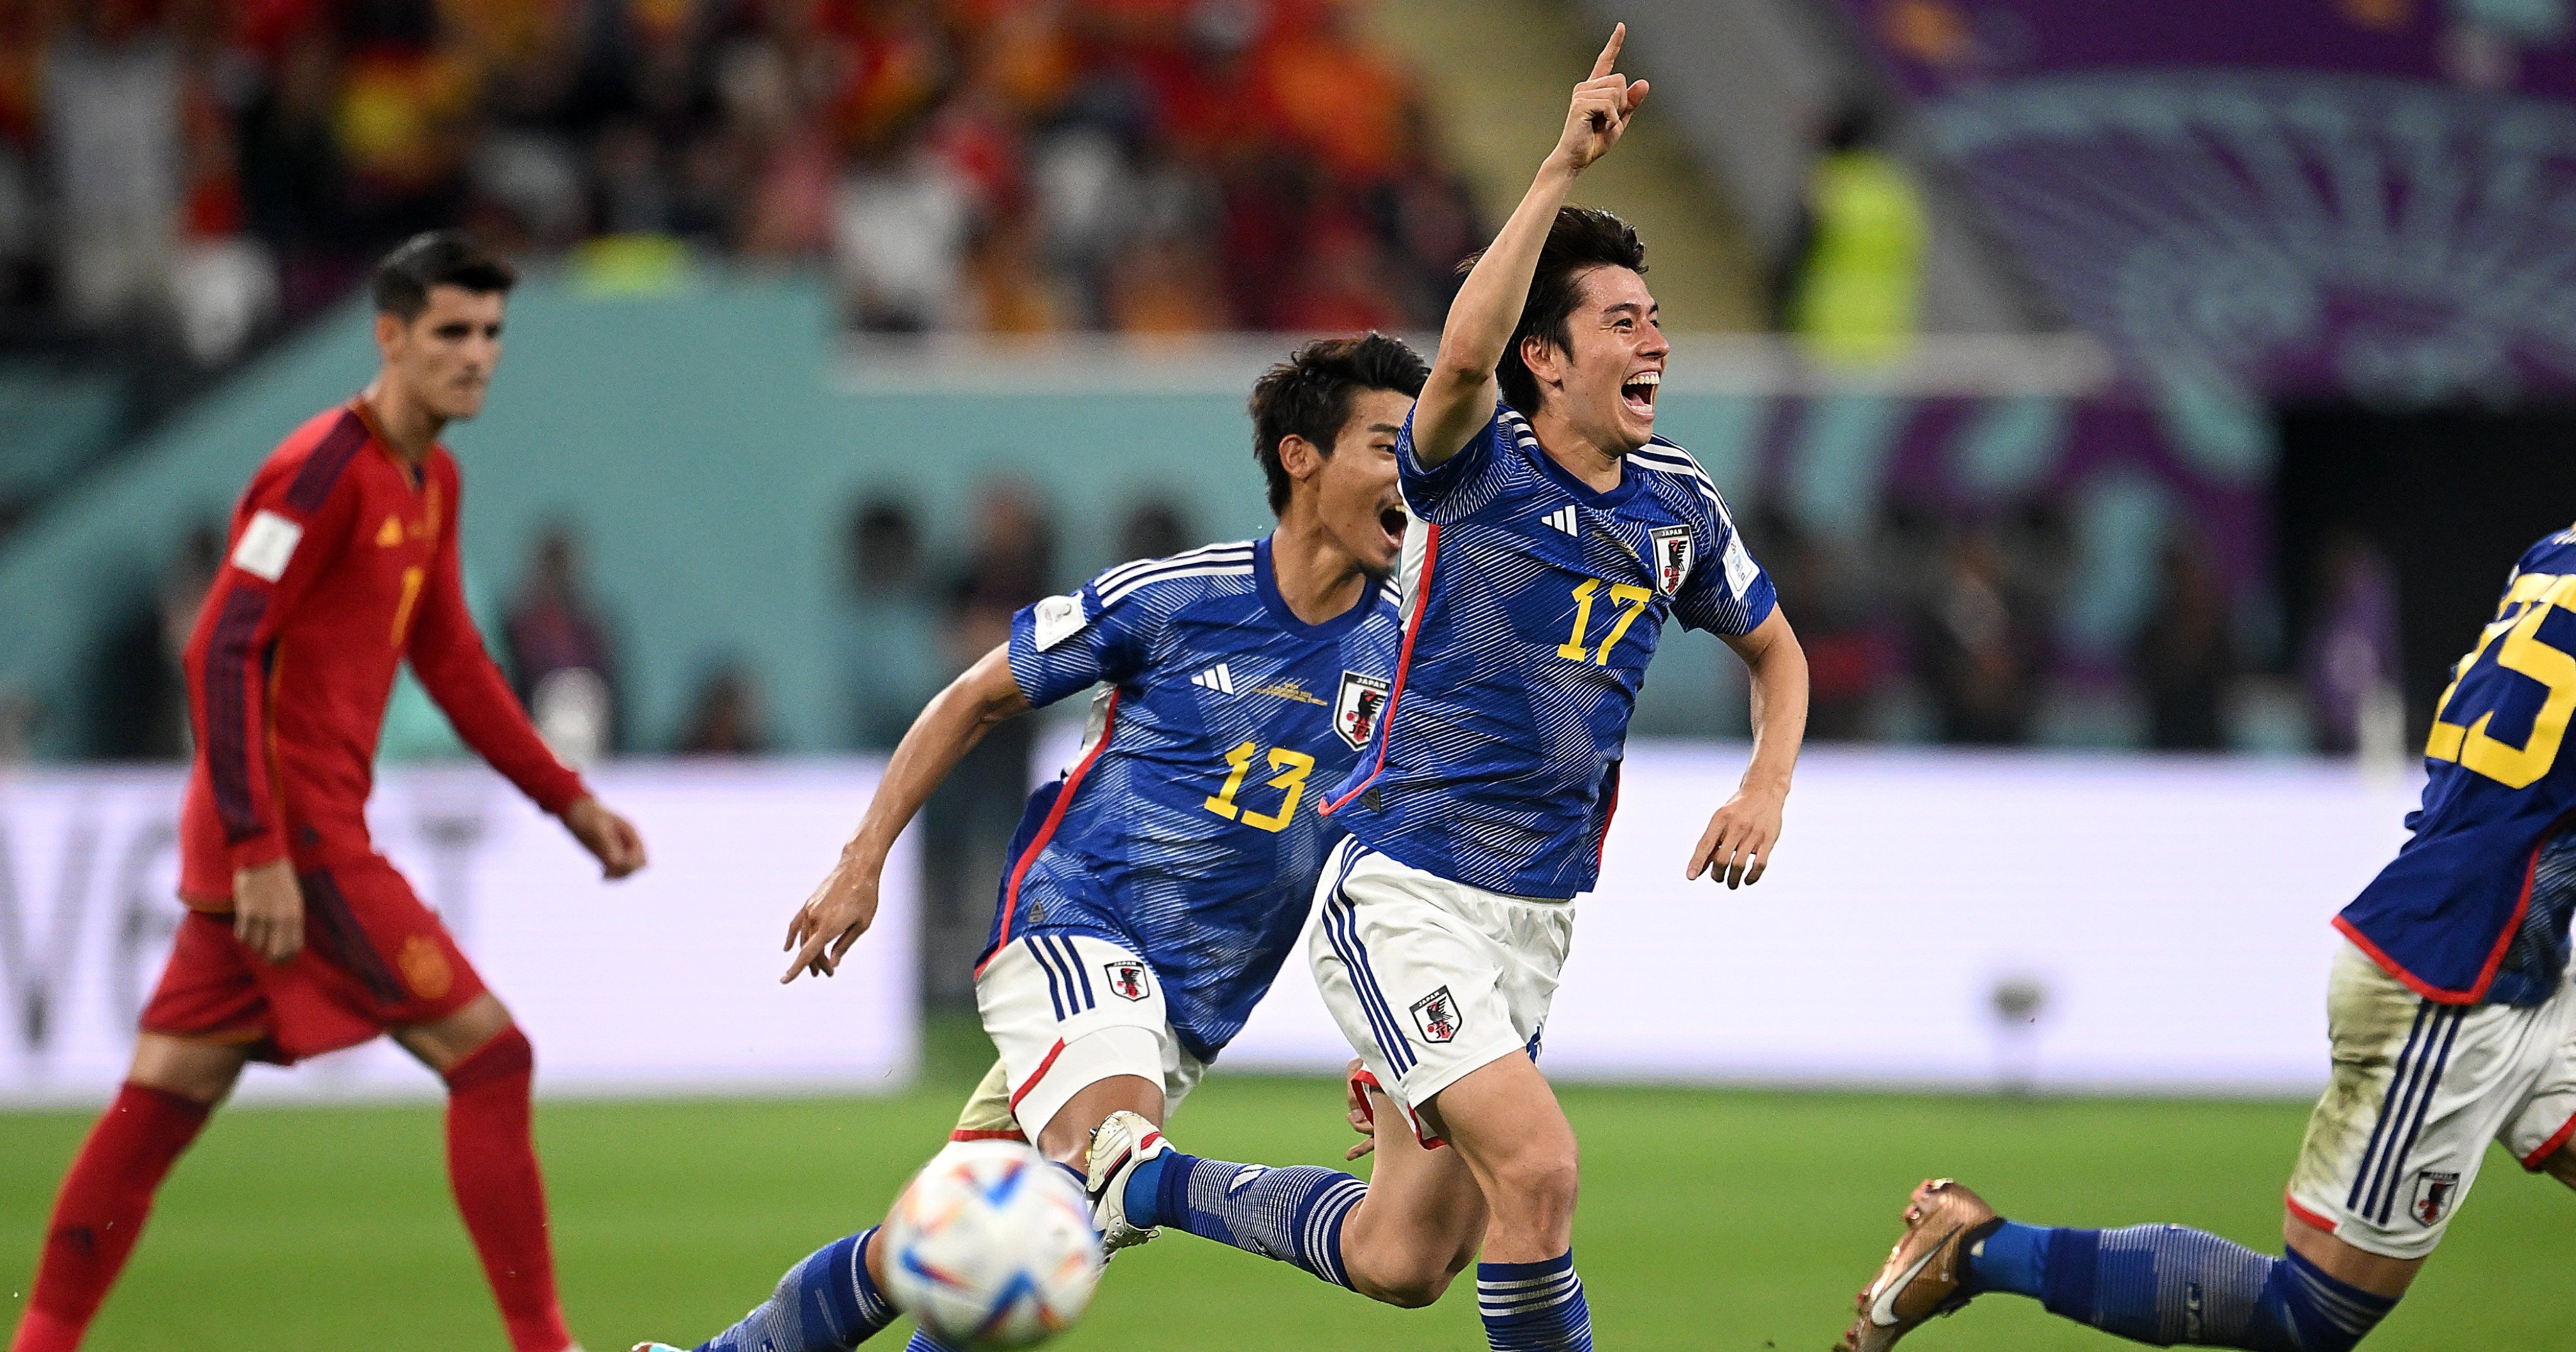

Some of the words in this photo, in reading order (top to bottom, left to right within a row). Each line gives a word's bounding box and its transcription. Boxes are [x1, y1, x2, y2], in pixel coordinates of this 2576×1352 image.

[1661, 528, 1683, 536] JAPAN
[1557, 578, 1652, 666] 17
[1357, 677, 1387, 689] JAPAN
[2425, 573, 2576, 790] 25
[1204, 741, 1315, 833] 13
[1418, 991, 1440, 1007] JAPAN
[1435, 1024, 1455, 1039] JFA
